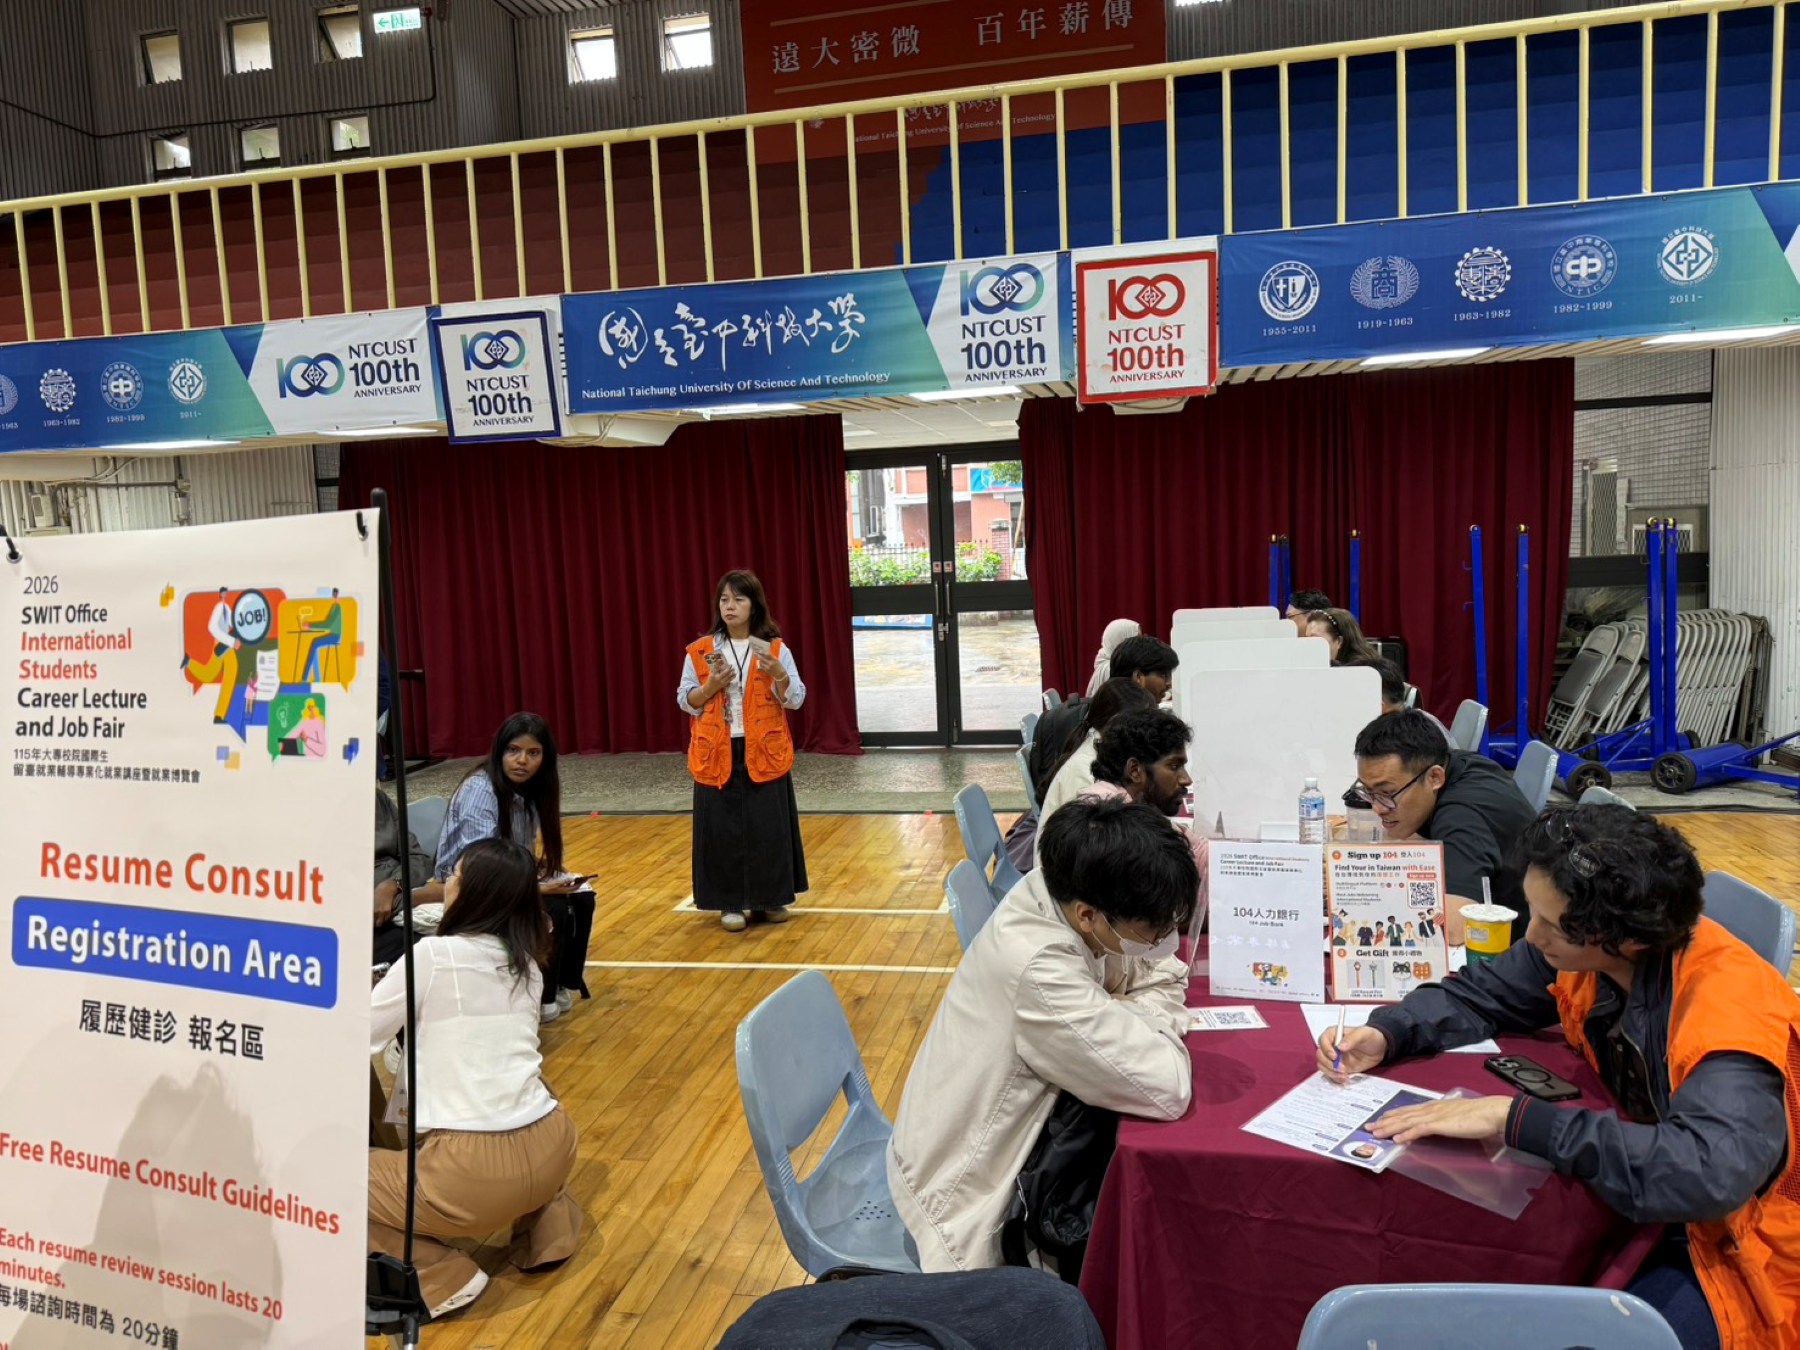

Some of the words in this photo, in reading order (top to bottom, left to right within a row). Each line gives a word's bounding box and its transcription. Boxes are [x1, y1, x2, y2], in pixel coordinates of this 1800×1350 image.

[772, 25, 920, 74] 遠大密微
[974, 0, 1133, 46] 百年薪傳
[965, 120, 994, 129] Science
[1012, 113, 1056, 125] Technology
[962, 315, 1046, 340] NTCUST
[1108, 324, 1186, 345] NTCUST
[349, 337, 417, 359] NTCUST
[961, 337, 1046, 370] 100th
[1107, 344, 1184, 371] 100th
[349, 358, 420, 387] 100th
[466, 375, 529, 392] NTCUST
[964, 367, 1048, 383] ANNIVERSARY
[1109, 369, 1185, 384] ANNIVERSARY
[354, 384, 422, 398] ANNIVERSARY
[581, 387, 625, 399] National
[628, 385, 677, 397] Taichung
[680, 380, 734, 394] University
[737, 379, 752, 391] Of
[754, 378, 797, 390] Science
[799, 374, 822, 386] And
[824, 371, 890, 384] Technology
[468, 392, 532, 416] 100th
[473, 415, 535, 427] ANNIVERSARY
[23, 575, 59, 595] 2026
[21, 605, 62, 625] SWIT
[65, 603, 108, 623] Office
[237, 609, 266, 628] JOB!
[21, 627, 132, 652] International
[19, 658, 98, 681] Students
[17, 687, 79, 710] Career
[83, 687, 147, 710] Lecture
[15, 715, 54, 738] and
[58, 716, 90, 738] Job
[93, 717, 125, 739] Fair
[14, 747, 109, 763] 115年大專校院國際生
[1347, 851, 1368, 860] Sign
[1370, 852, 1381, 860] up
[40, 841, 173, 889] Resume
[184, 852, 324, 905] Consult
[1233, 906, 1300, 921] 104人力銀行
[27, 914, 232, 974] Registration
[243, 938, 322, 988] Area
[1356, 949, 1371, 957] Get
[1372, 949, 1389, 957] Gift
[79, 999, 177, 1044] 履歷健診
[188, 1015, 264, 1061] 報名區
[0, 1132, 44, 1163] Free
[50, 1140, 131, 1180] Resume
[135, 1158, 217, 1201] Consult
[222, 1179, 340, 1235] Guidelines
[0, 1227, 35, 1252] Each
[39, 1239, 97, 1267] resume
[101, 1251, 155, 1281] review
[158, 1268, 217, 1301] session
[221, 1281, 258, 1314] lasts
[262, 1299, 283, 1321] 20
[0, 1260, 66, 1289] minutes.
[0, 1284, 115, 1335] 每場諮詢時間為
[123, 1316, 179, 1350] 20分鐘
